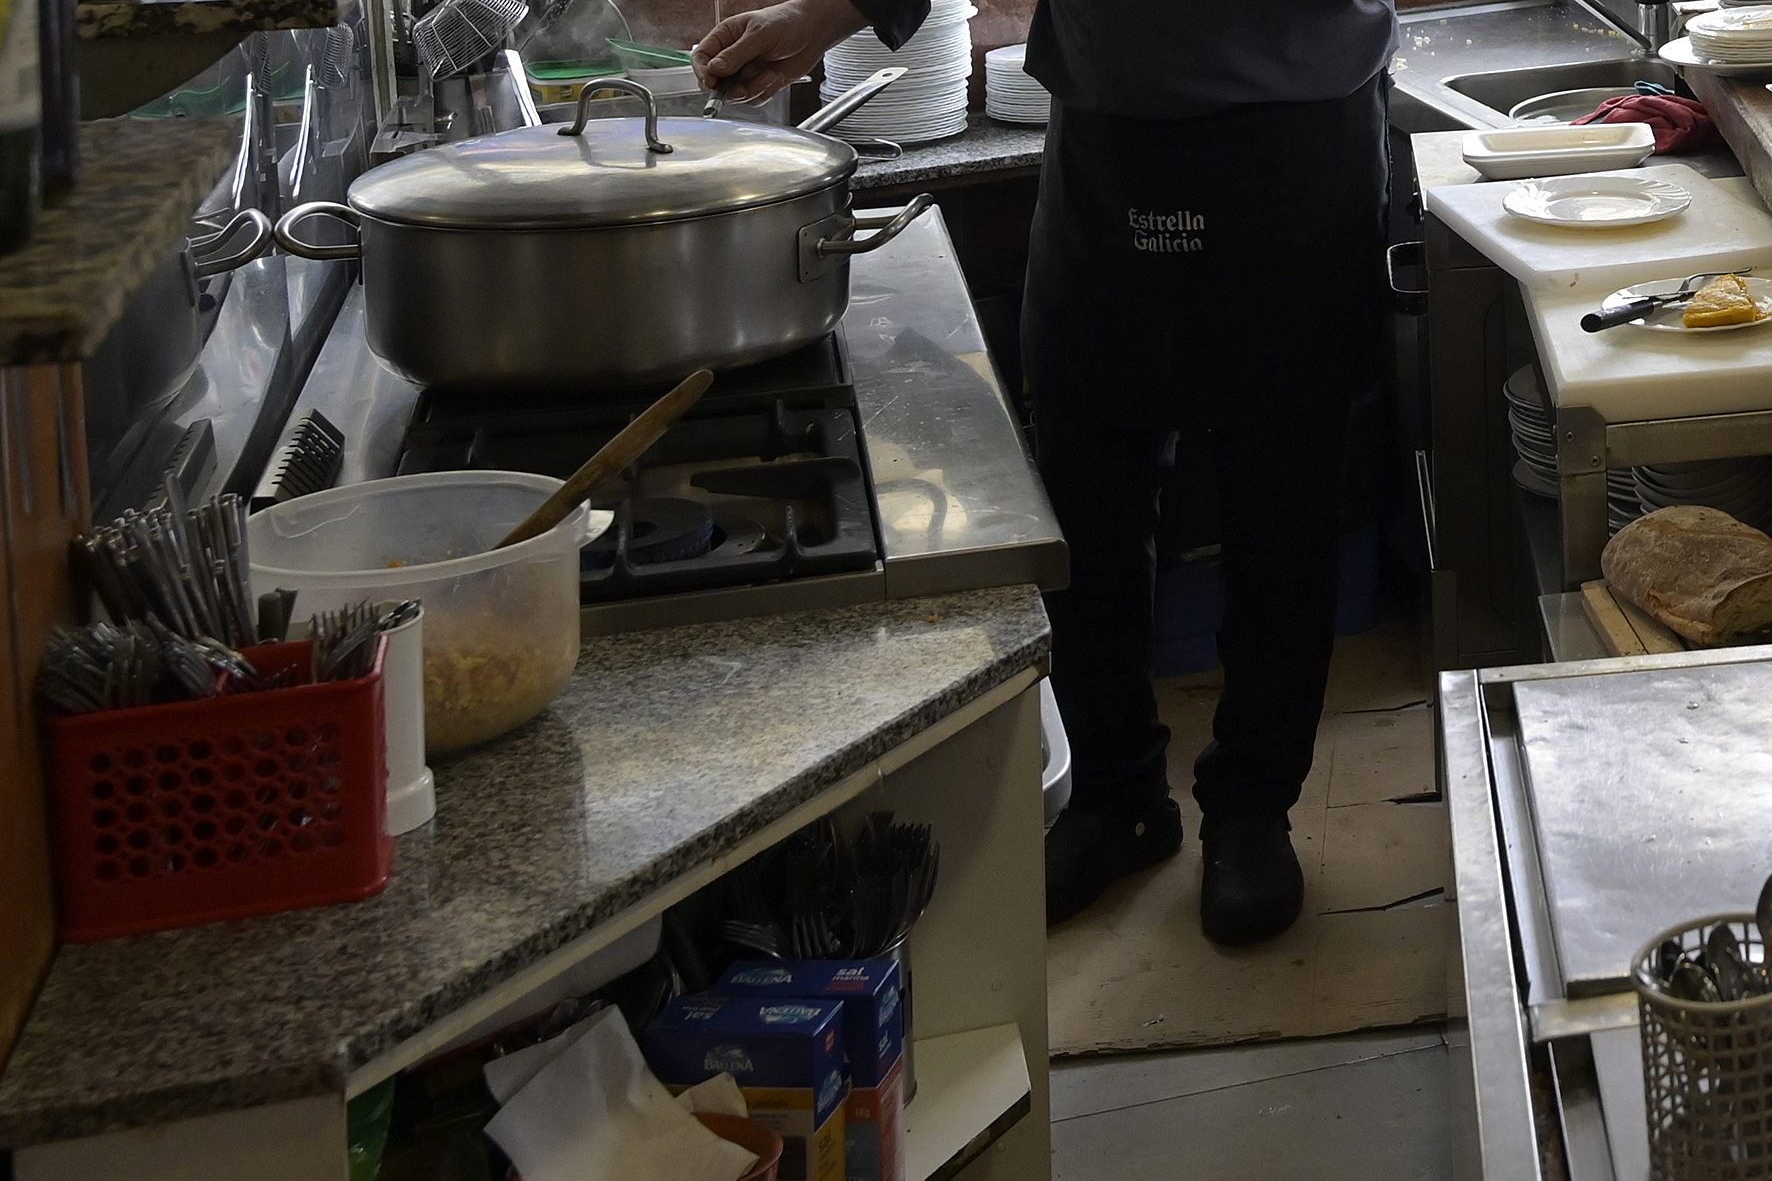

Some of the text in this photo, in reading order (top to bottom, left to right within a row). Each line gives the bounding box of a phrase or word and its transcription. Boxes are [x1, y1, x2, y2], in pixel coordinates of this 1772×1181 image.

[1128, 208, 1205, 231] Estrella
[1134, 230, 1203, 253] Galicia
[836, 967, 865, 976] sal
